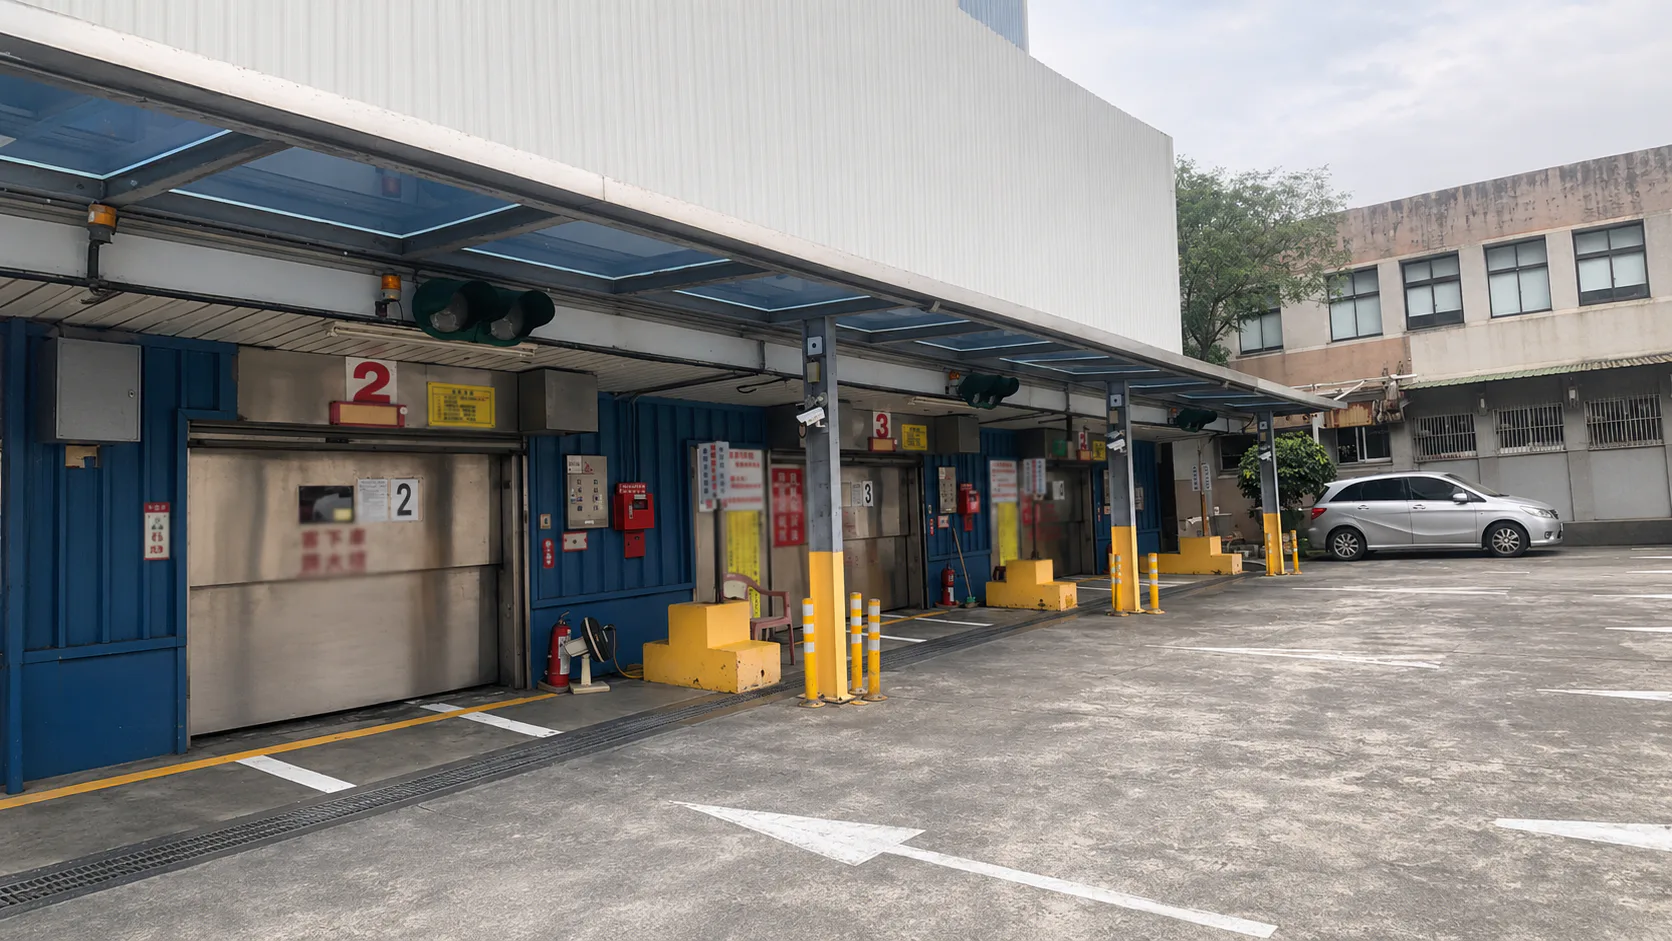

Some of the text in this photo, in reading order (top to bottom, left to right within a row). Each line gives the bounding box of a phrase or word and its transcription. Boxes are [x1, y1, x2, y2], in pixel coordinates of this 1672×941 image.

[353, 361, 390, 403] 2
[876, 413, 888, 438] 3
[396, 483, 412, 516] 2
[865, 484, 871, 503] 3
